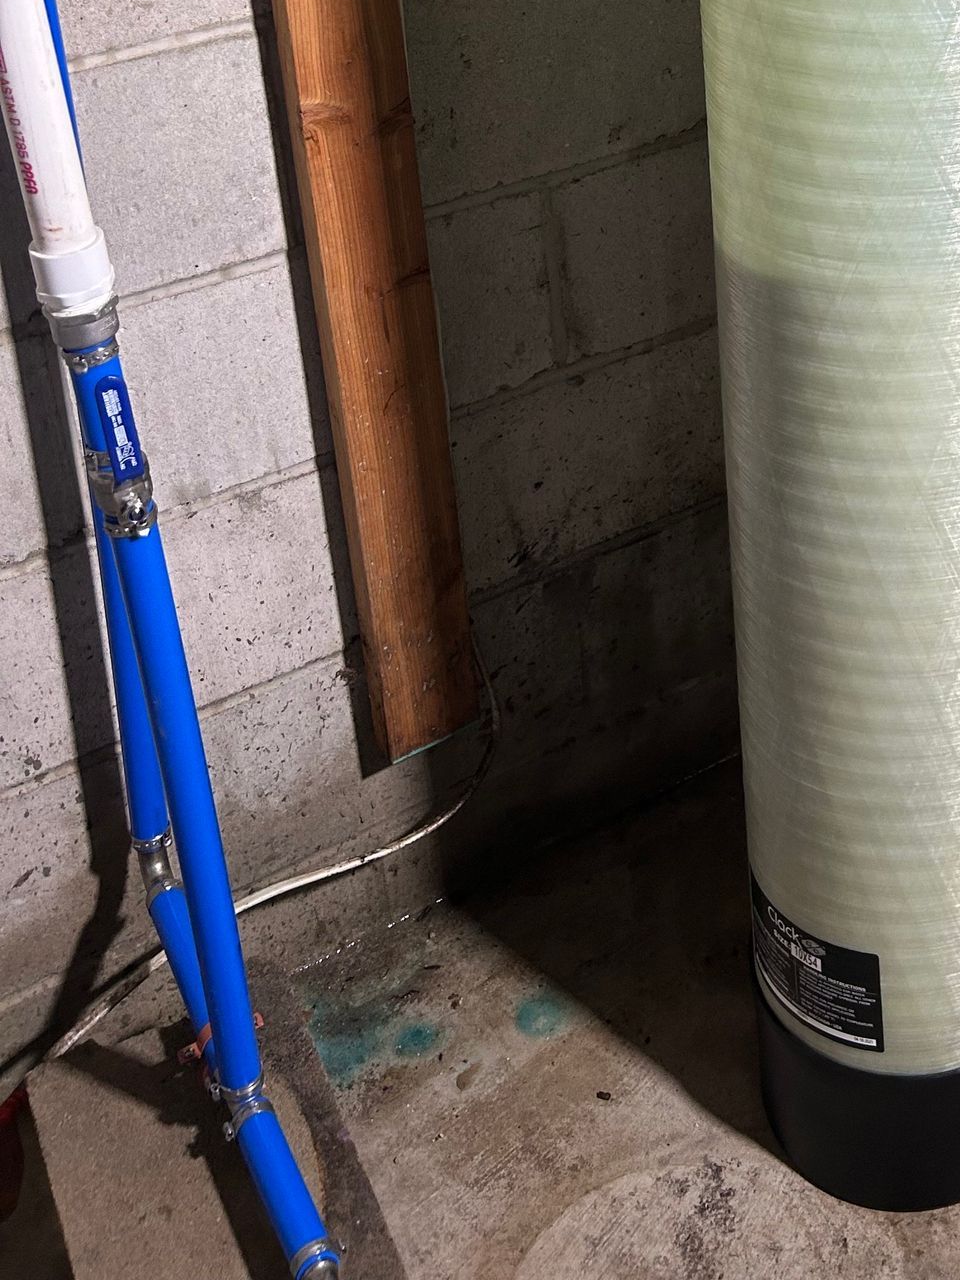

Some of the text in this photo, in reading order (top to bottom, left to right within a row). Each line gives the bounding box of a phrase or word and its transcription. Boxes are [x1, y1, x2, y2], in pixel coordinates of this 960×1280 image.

[0, 78, 16, 113] ASTM
[13, 131, 29, 159] 1785
[768, 906, 803, 950] Clack
